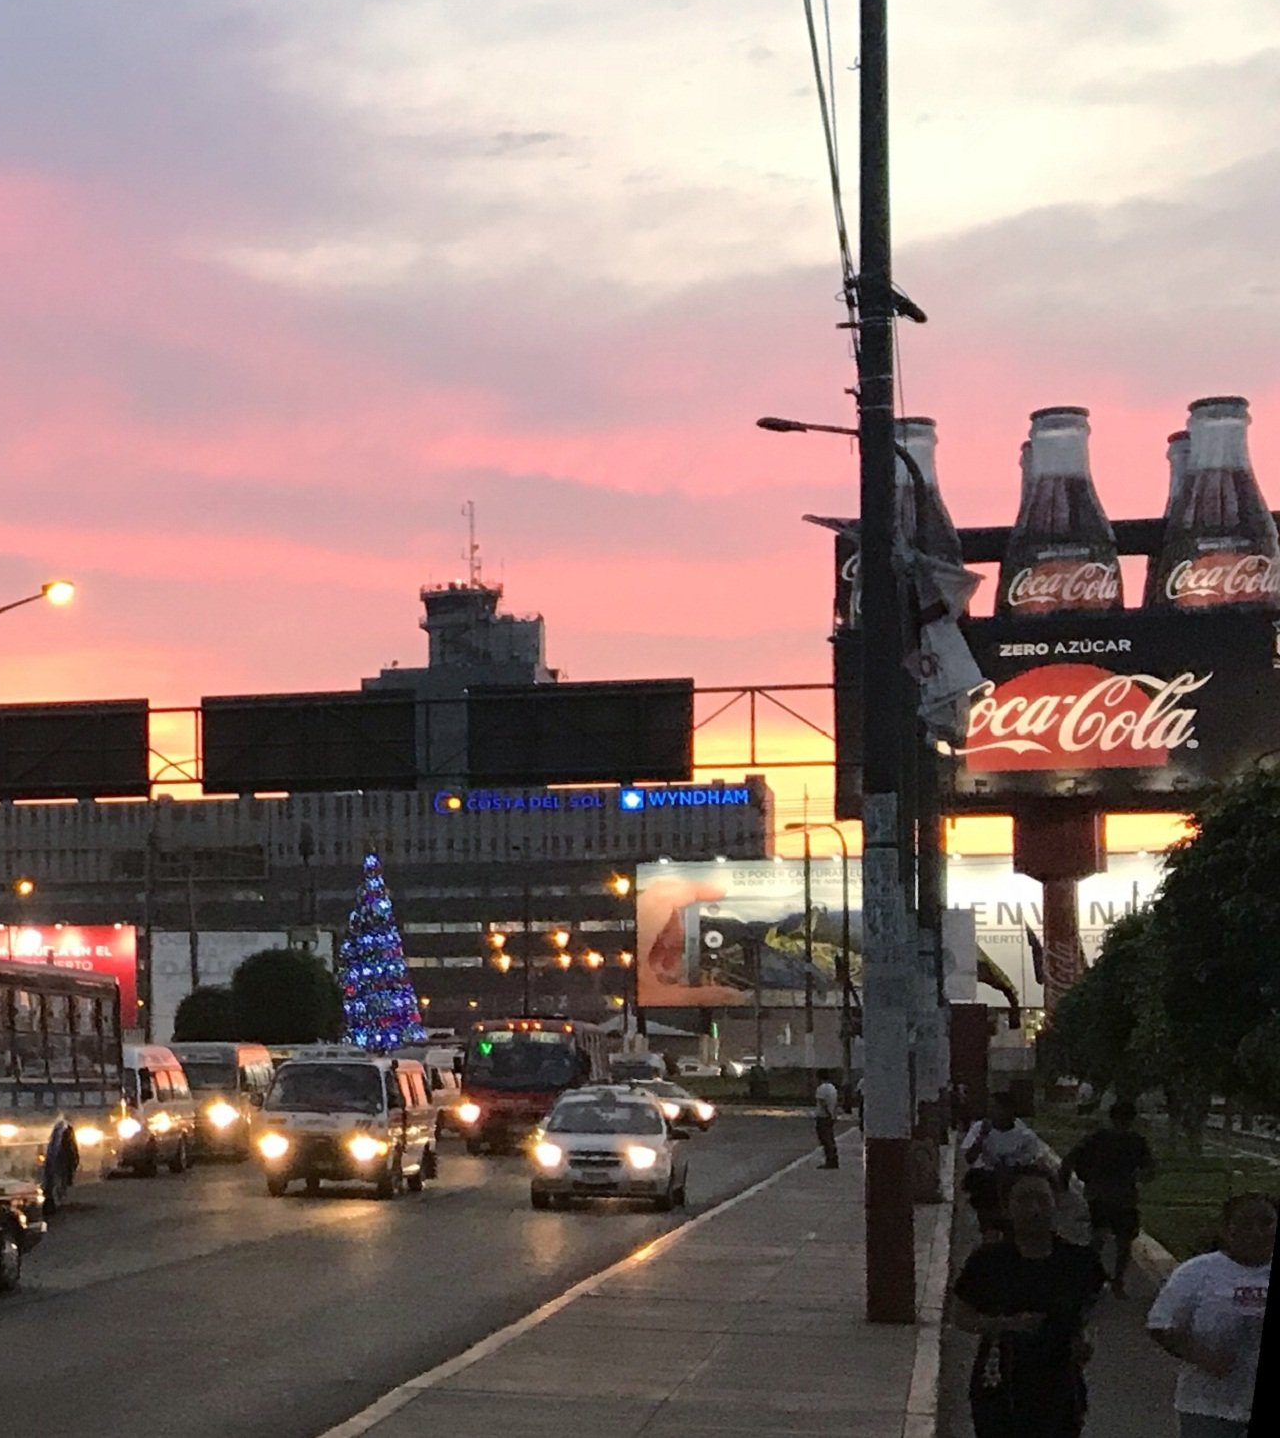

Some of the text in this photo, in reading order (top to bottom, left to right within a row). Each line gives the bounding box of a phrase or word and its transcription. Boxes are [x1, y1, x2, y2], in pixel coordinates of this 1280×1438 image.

[1008, 562, 1119, 606] Coca-Cola
[999, 638, 1132, 656] ZERO AZÚCAR
[466, 794, 604, 810] COSTA DEL SOL
[648, 789, 749, 806] WYNDHAM
[95, 945, 112, 956] EL
